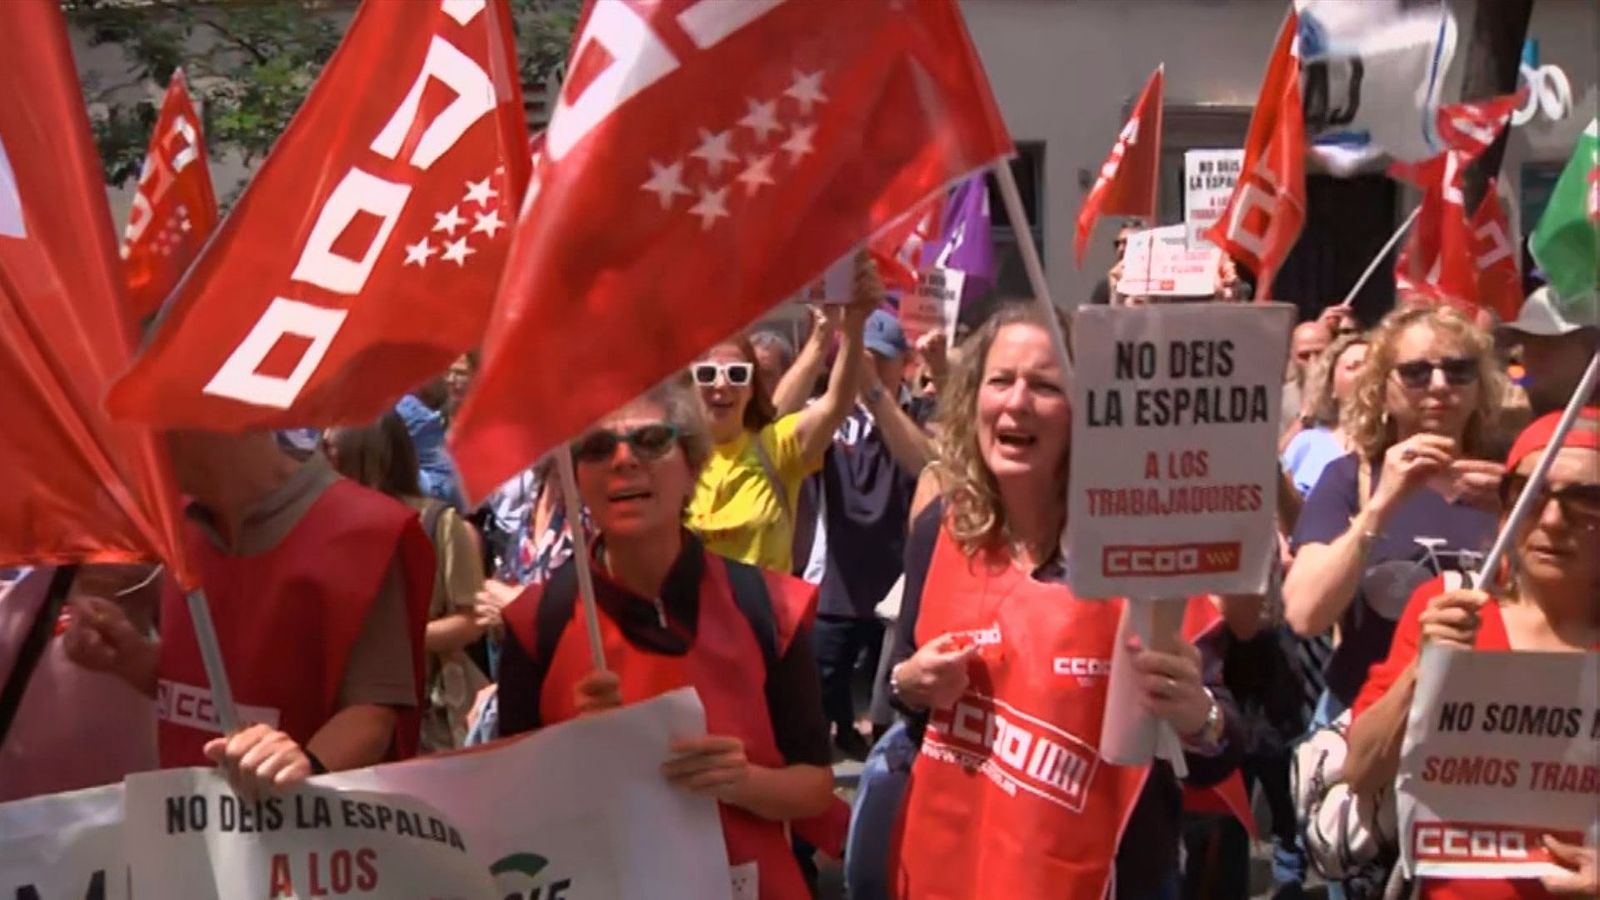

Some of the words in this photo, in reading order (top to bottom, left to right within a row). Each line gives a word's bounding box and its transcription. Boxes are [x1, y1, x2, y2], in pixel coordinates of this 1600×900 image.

[203, 0, 498, 410] COO
[1115, 341, 1155, 380] NO
[1169, 340, 1235, 379] DEIS
[1087, 389, 1122, 427] LA
[1135, 385, 1268, 427] ESPALDA
[1144, 450, 1159, 479] A
[1167, 450, 1209, 480] LOS
[1085, 485, 1263, 517] TRABAJADORES
[1106, 550, 1198, 572] CCOO
[1438, 701, 1475, 732] NO
[1482, 702, 1583, 738] SOMOS
[1421, 755, 1521, 788] SOMOS
[1529, 760, 1600, 795] TRAB
[166, 795, 207, 834] NO
[220, 796, 284, 833] DEIS
[295, 795, 333, 829] LA
[341, 800, 467, 852] ESPALDA
[1415, 827, 1529, 859] CCOO
[268, 852, 293, 899] A
[307, 847, 379, 898] LOS
